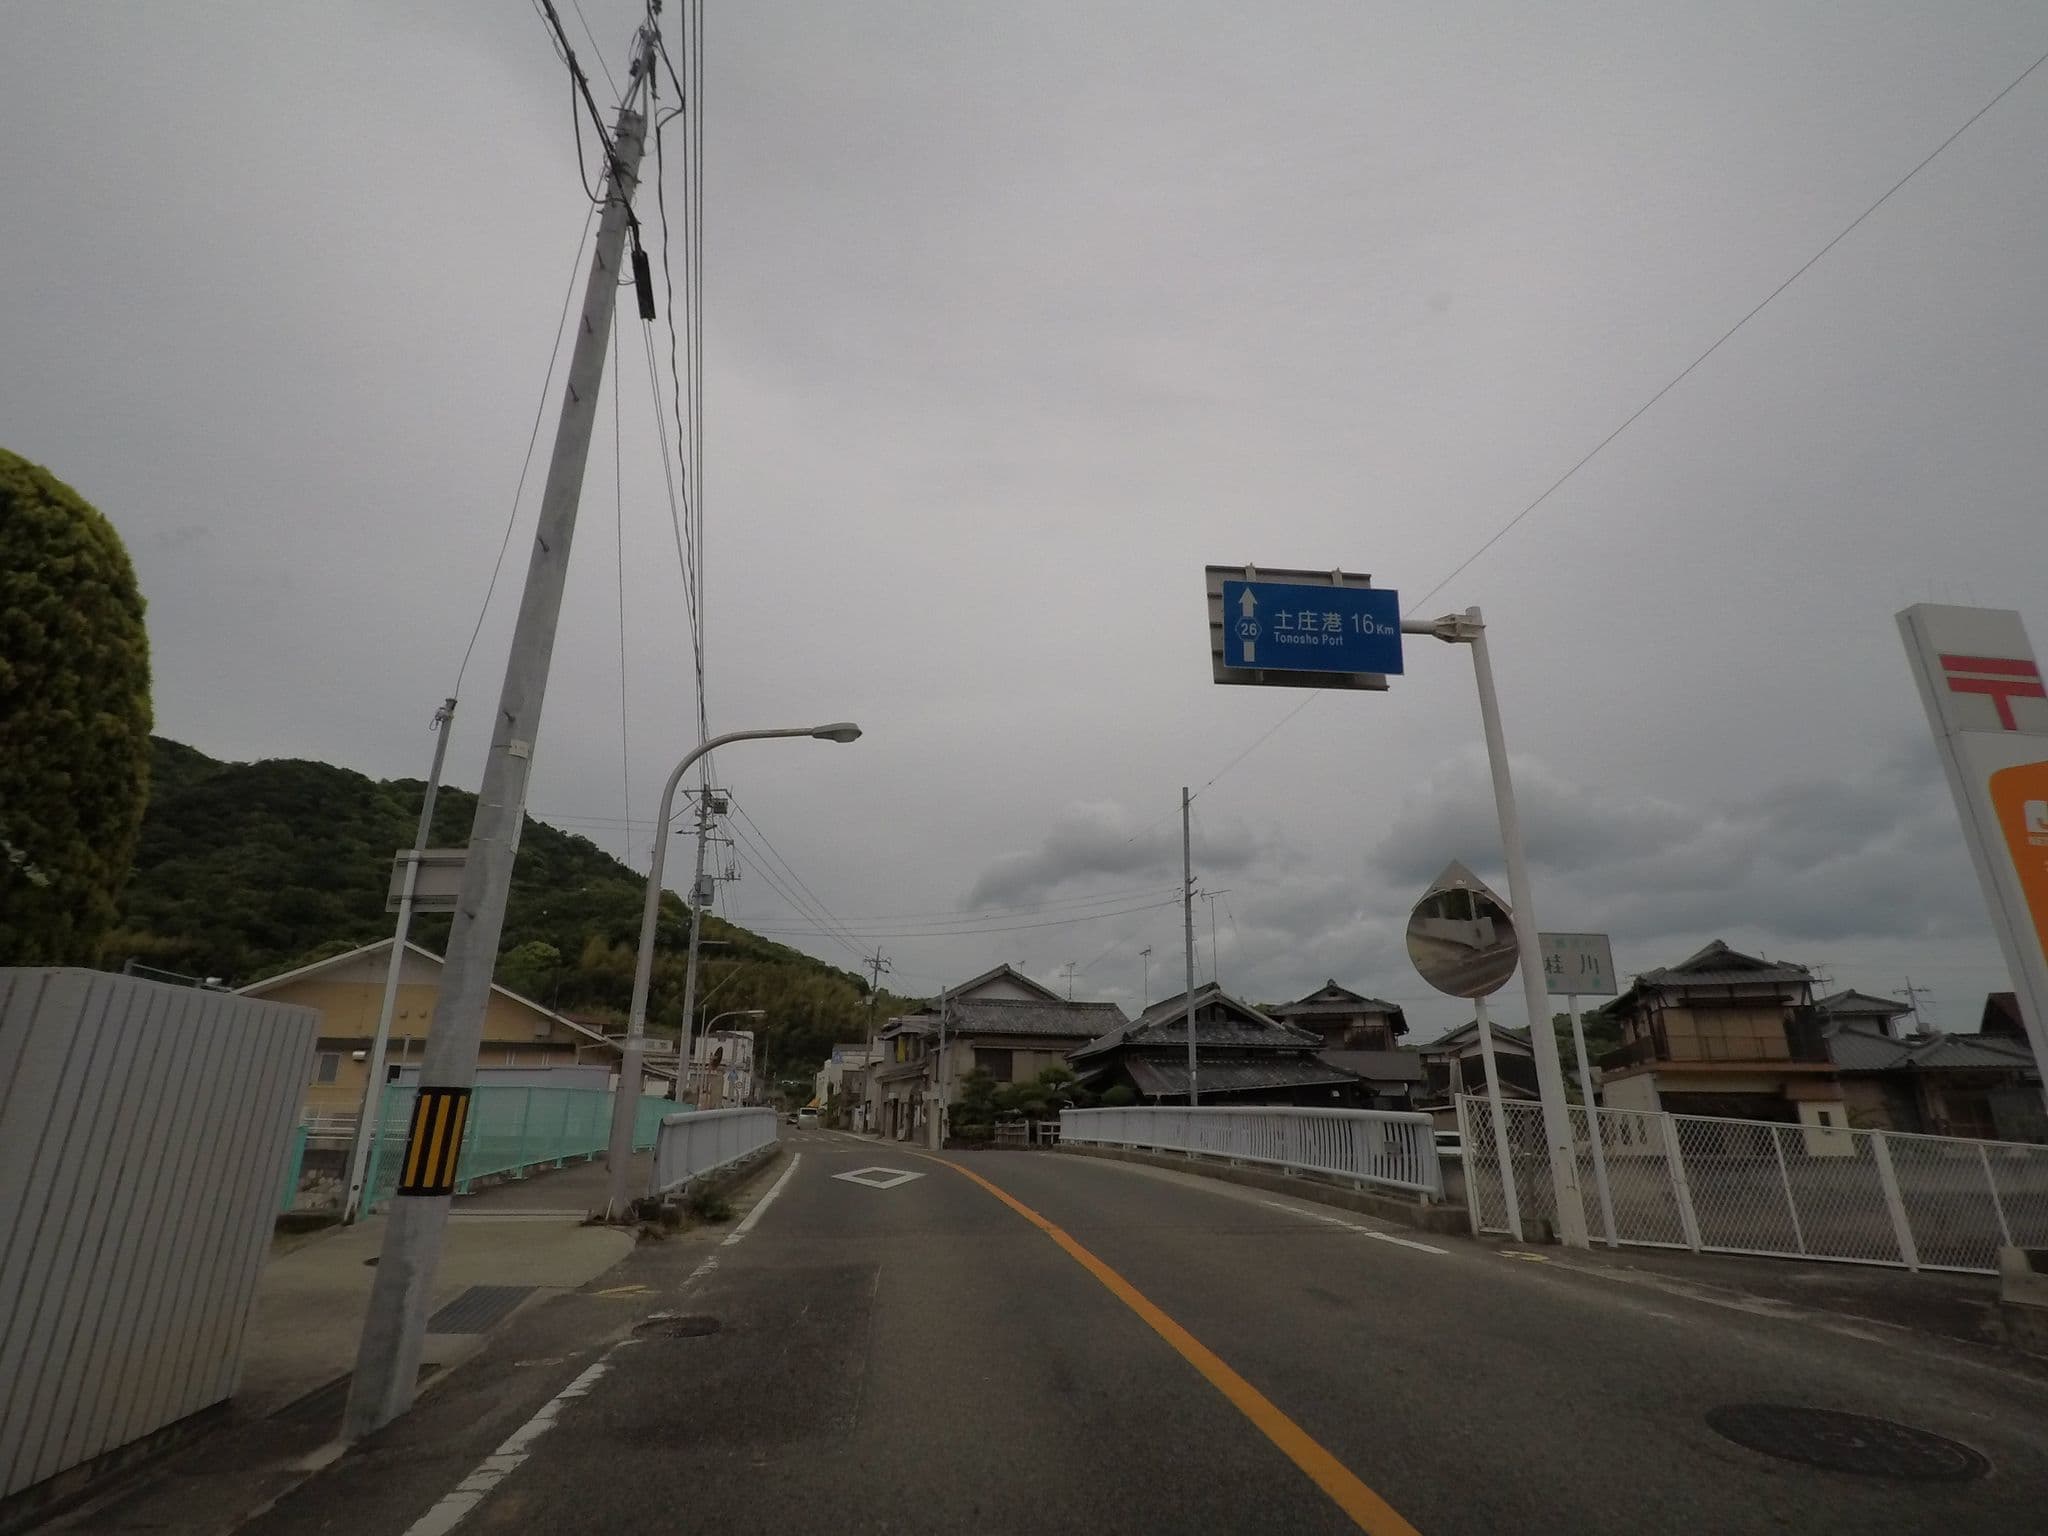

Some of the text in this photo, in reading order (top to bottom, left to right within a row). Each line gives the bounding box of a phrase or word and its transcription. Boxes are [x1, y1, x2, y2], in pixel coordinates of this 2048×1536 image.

[1274, 610, 1343, 633] 土庄港
[1240, 623, 1257, 636] 26
[1274, 632, 1343, 646] Tonosho Port
